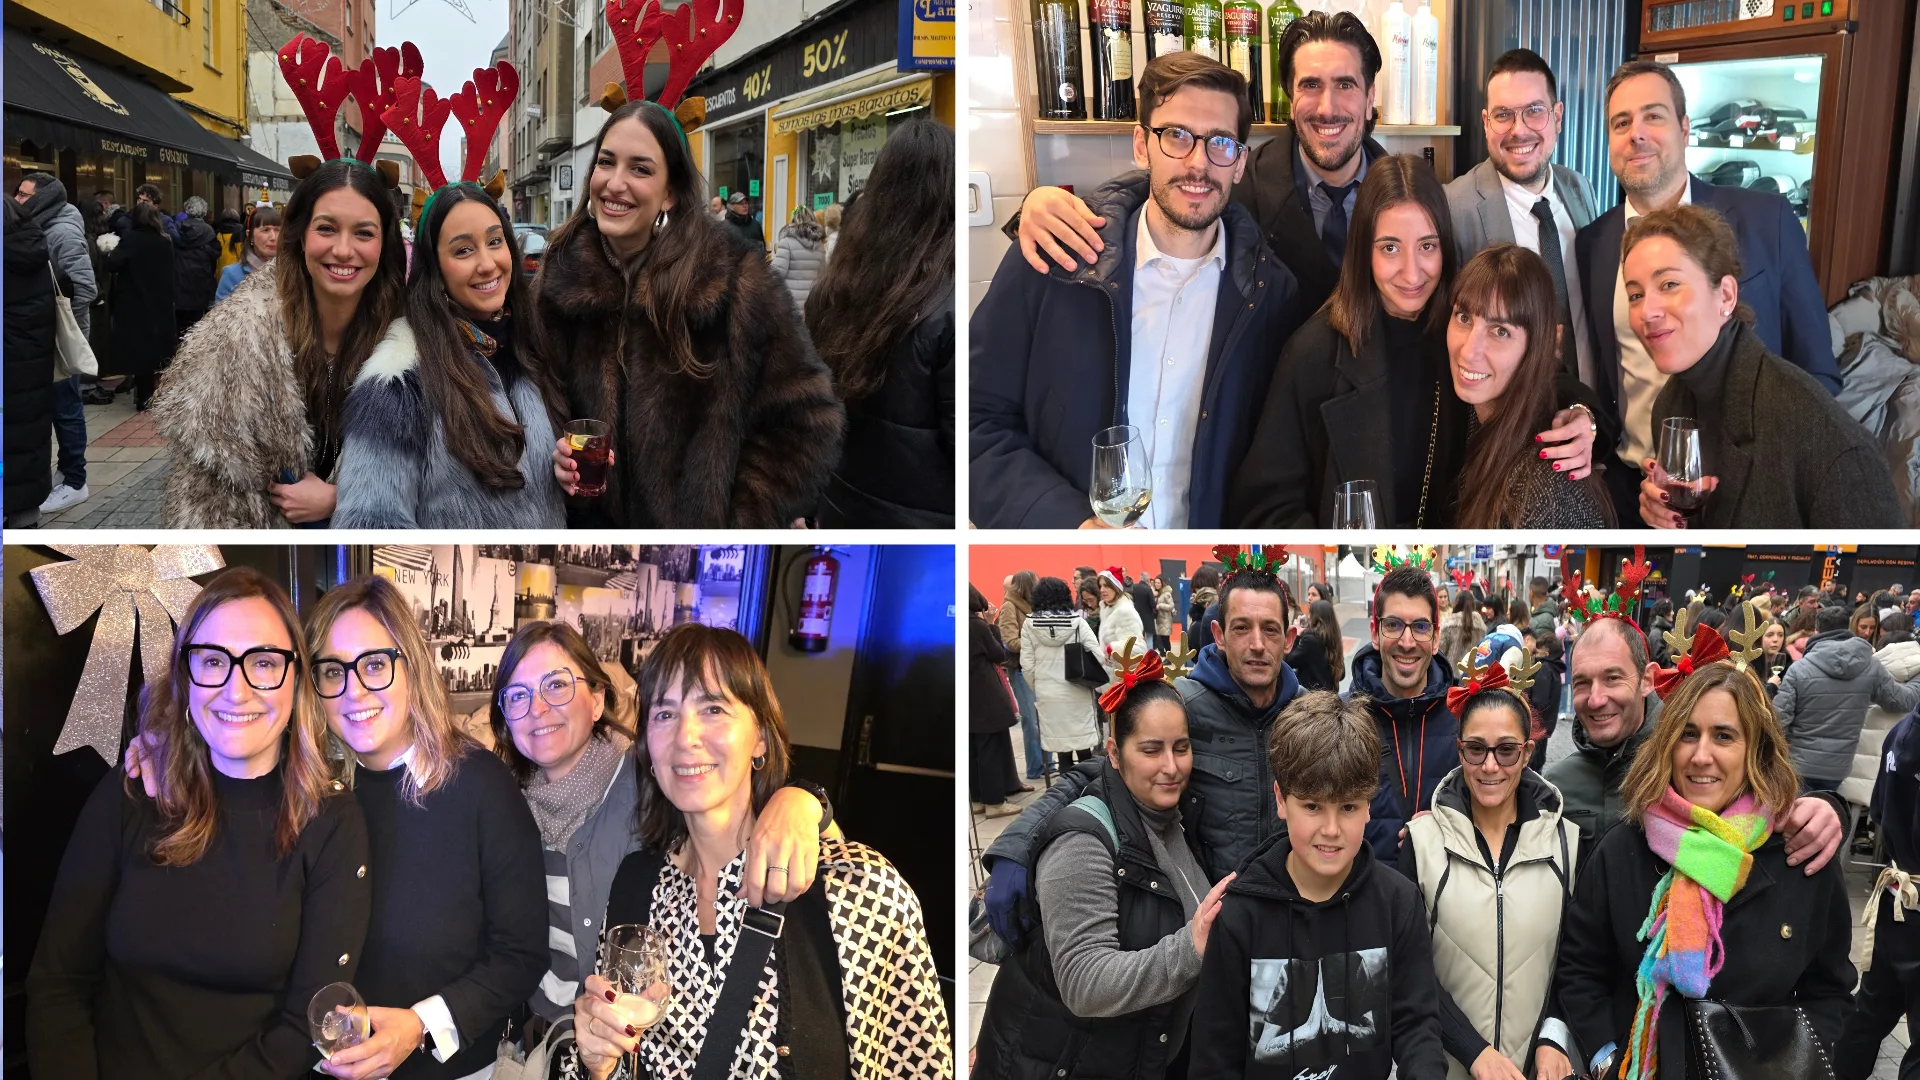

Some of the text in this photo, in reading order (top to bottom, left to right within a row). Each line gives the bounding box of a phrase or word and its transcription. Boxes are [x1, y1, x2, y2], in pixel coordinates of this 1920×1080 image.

[743, 64, 772, 102] 40%
[803, 29, 848, 78] 50%
[394, 568, 450, 588] NEW YORK
